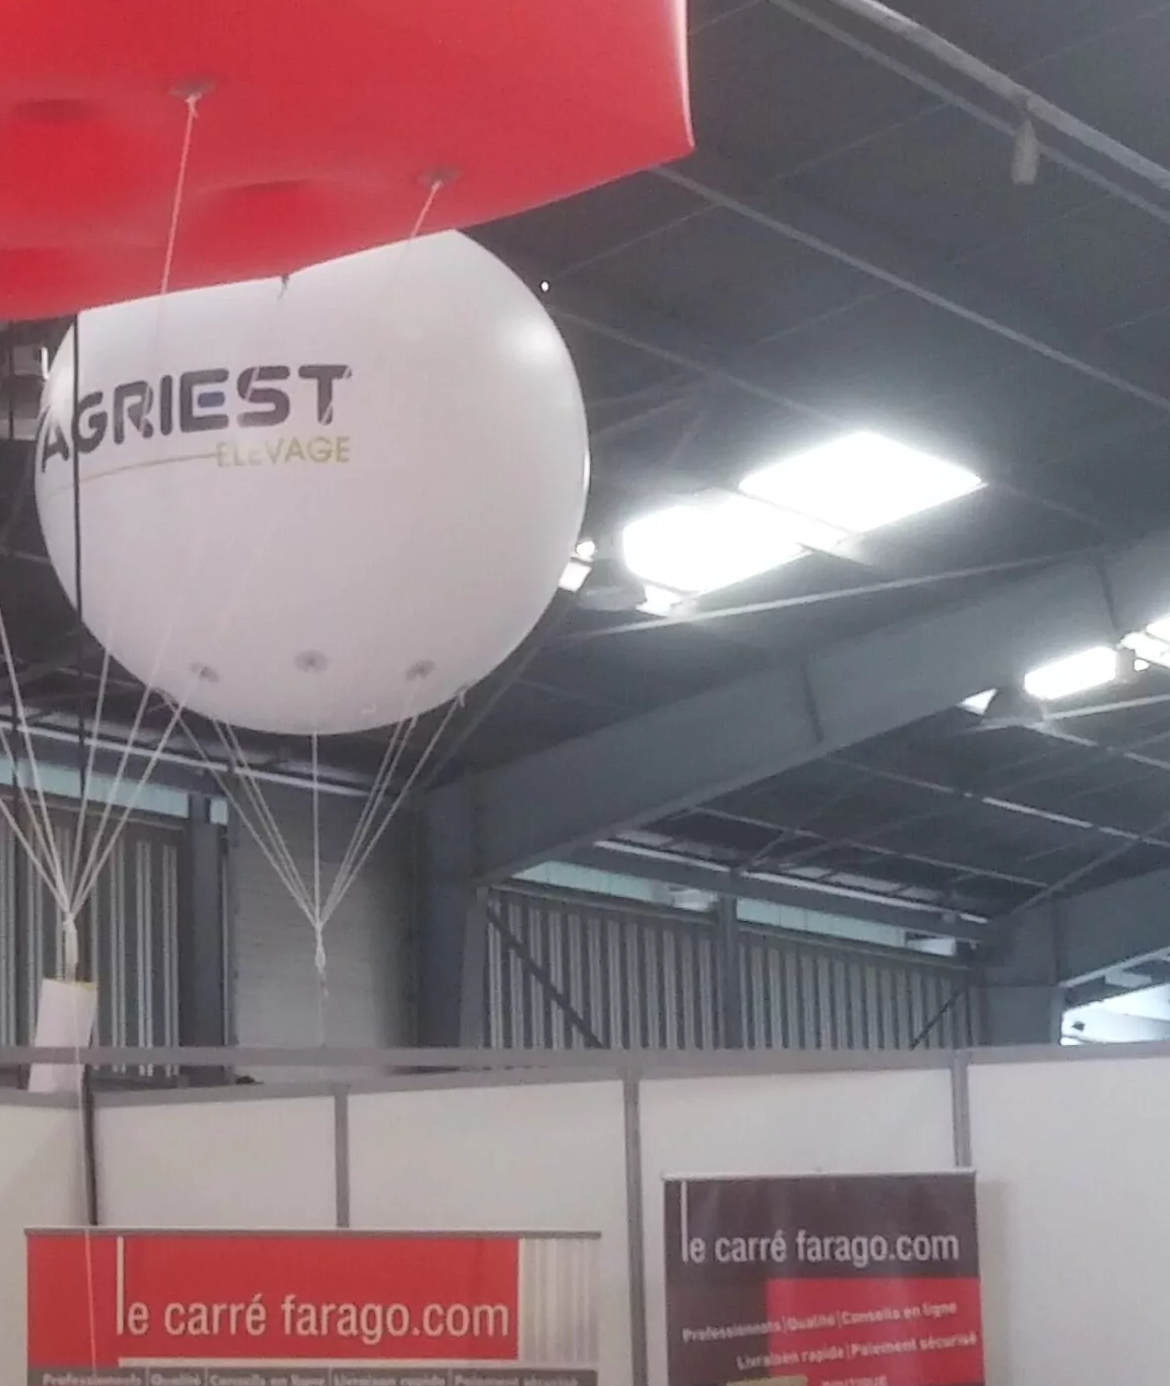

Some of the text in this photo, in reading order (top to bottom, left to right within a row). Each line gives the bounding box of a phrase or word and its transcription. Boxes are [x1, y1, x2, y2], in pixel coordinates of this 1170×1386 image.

[41, 365, 353, 474] AGRIEST
[216, 436, 350, 468] ELEVAGE
[681, 1180, 960, 1268] le carré farago.com
[116, 1236, 510, 1344] le carré farago.com
